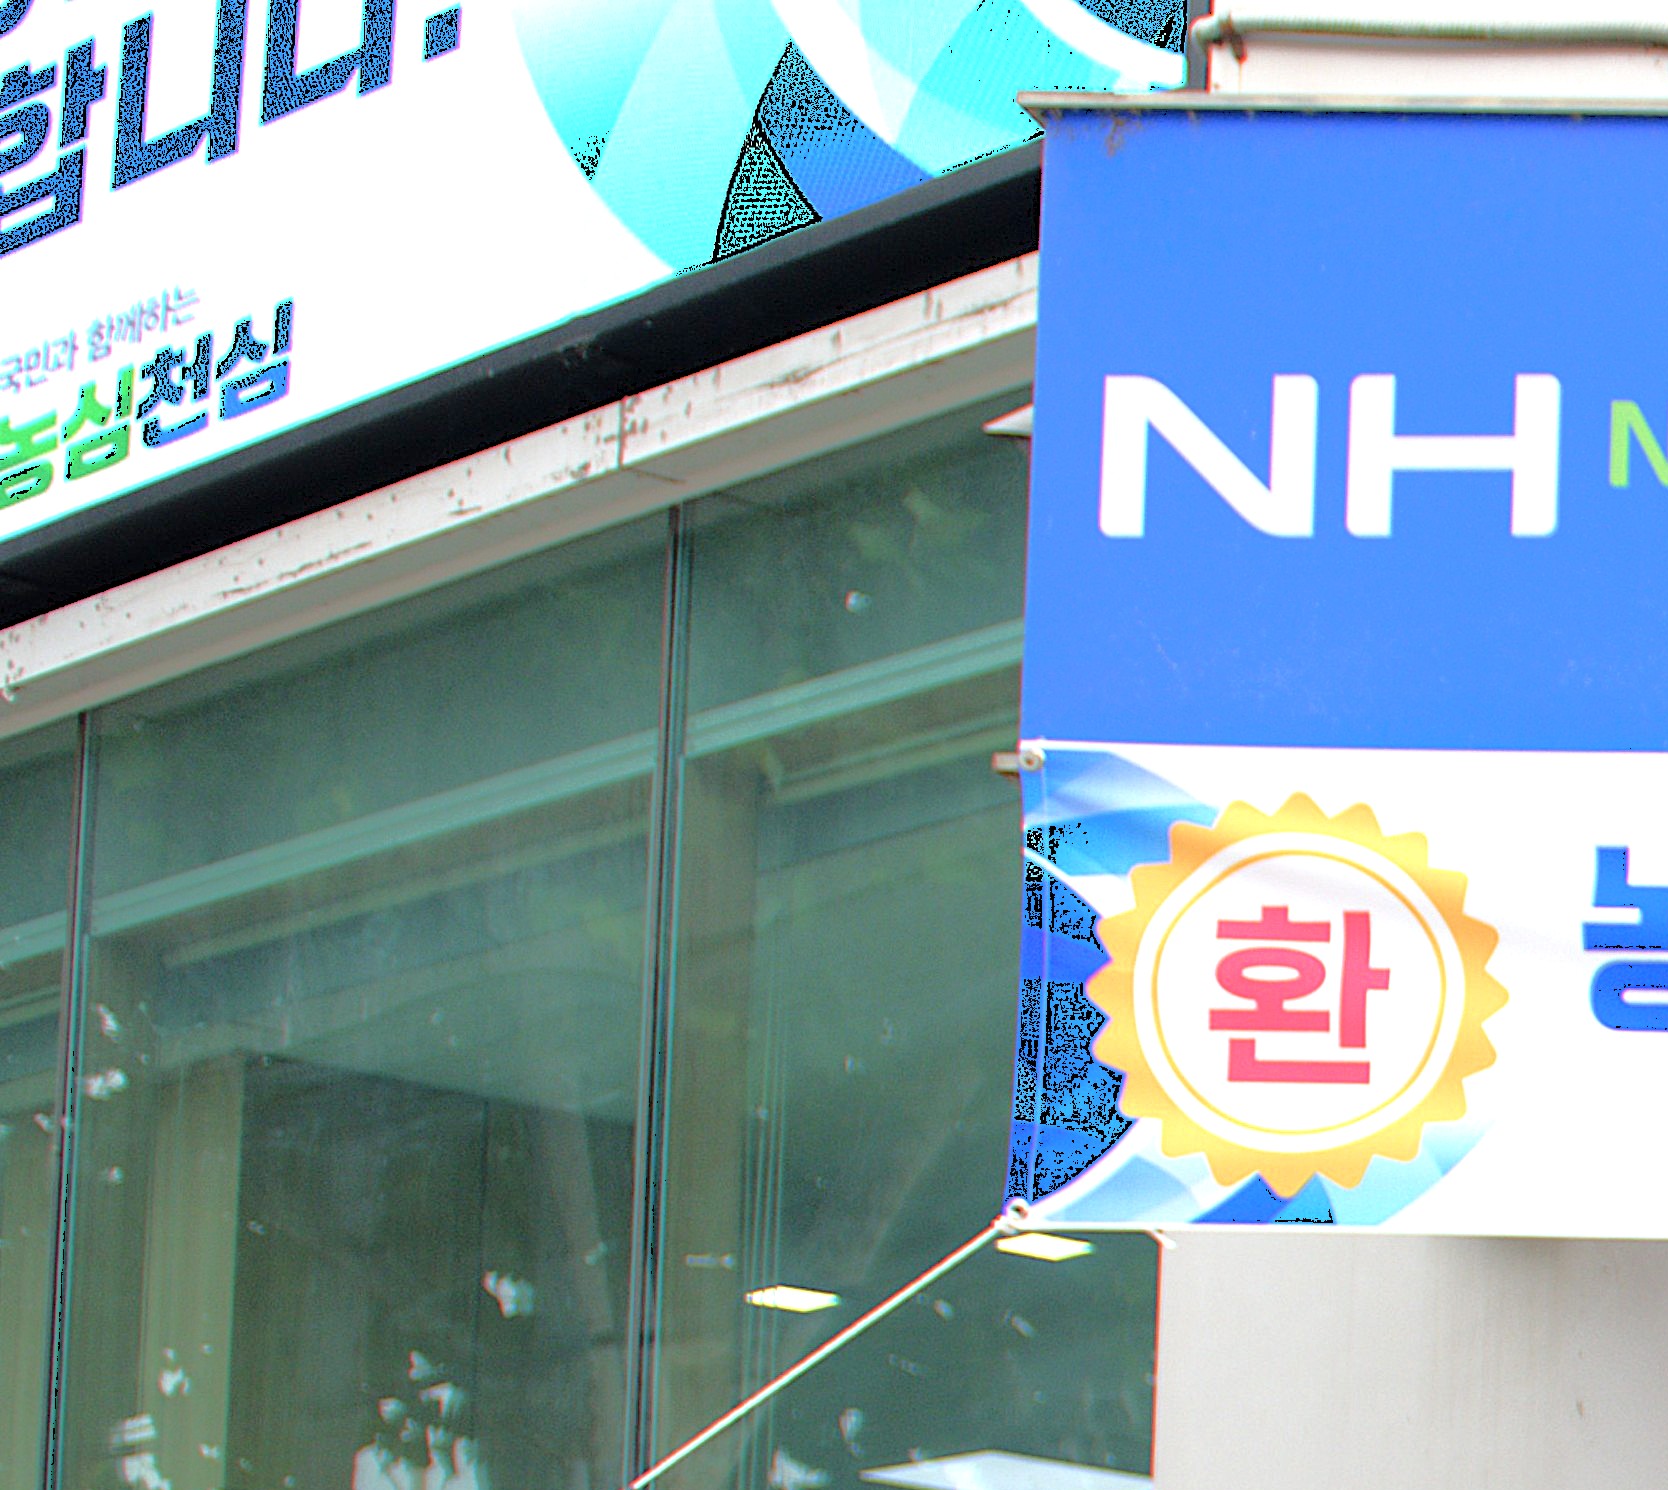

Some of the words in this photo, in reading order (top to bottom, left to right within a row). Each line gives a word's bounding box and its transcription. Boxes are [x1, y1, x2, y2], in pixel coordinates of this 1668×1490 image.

[0, 298, 293, 510] 농심천심
[86, 286, 200, 362] 함께하는
[1100, 374, 1560, 537] NH
[1208, 905, 1391, 1086] 환
